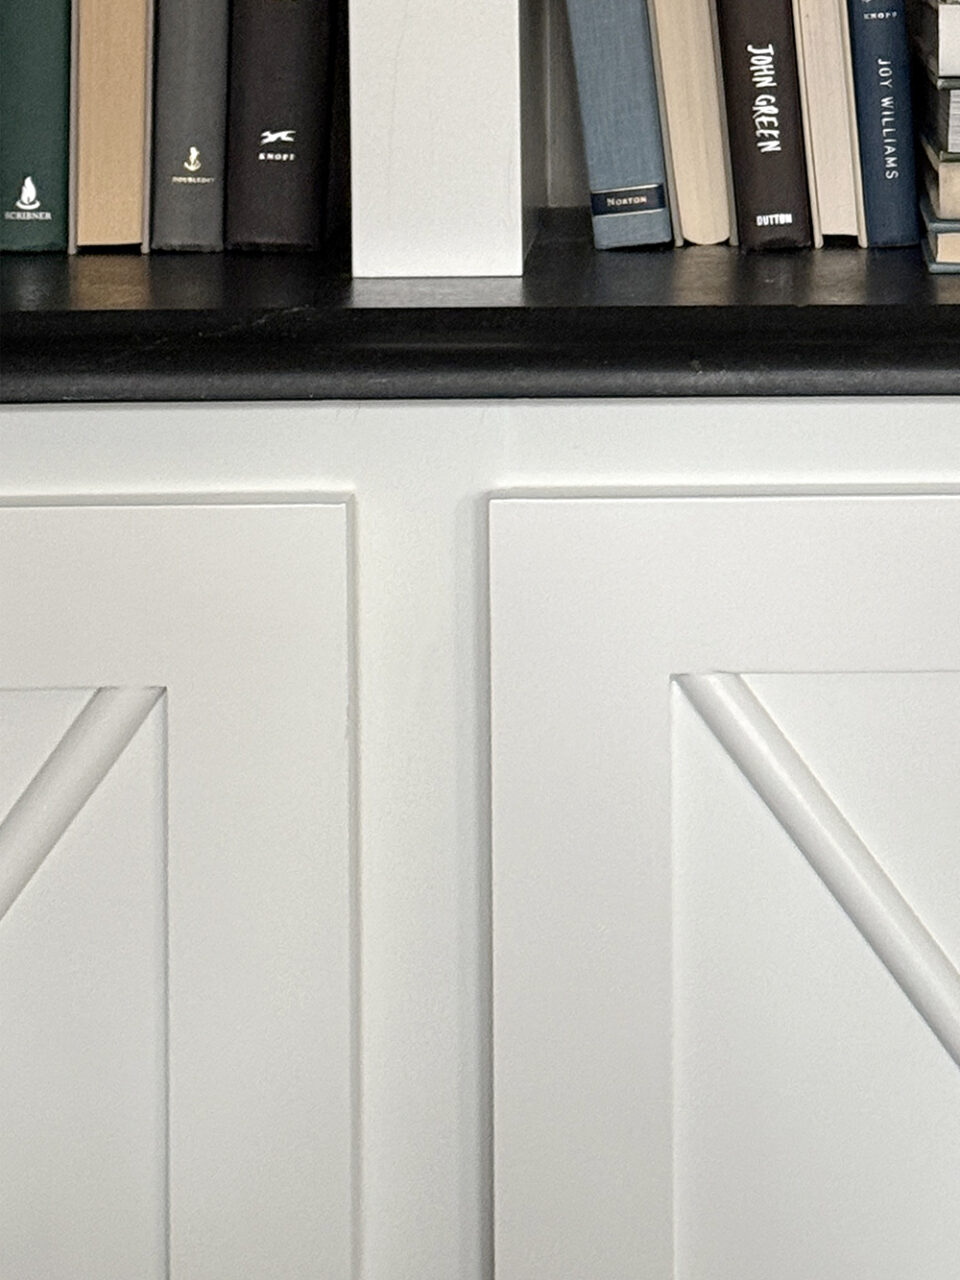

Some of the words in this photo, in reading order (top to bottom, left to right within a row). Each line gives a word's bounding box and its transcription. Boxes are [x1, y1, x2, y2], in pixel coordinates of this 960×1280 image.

[747, 43, 777, 88] JOHN
[877, 58, 893, 88] JOY
[752, 94, 782, 153] GREEN
[880, 95, 899, 180] WILLIAMS
[606, 196, 648, 207] NORTON
[756, 213, 793, 226] DUTTON
